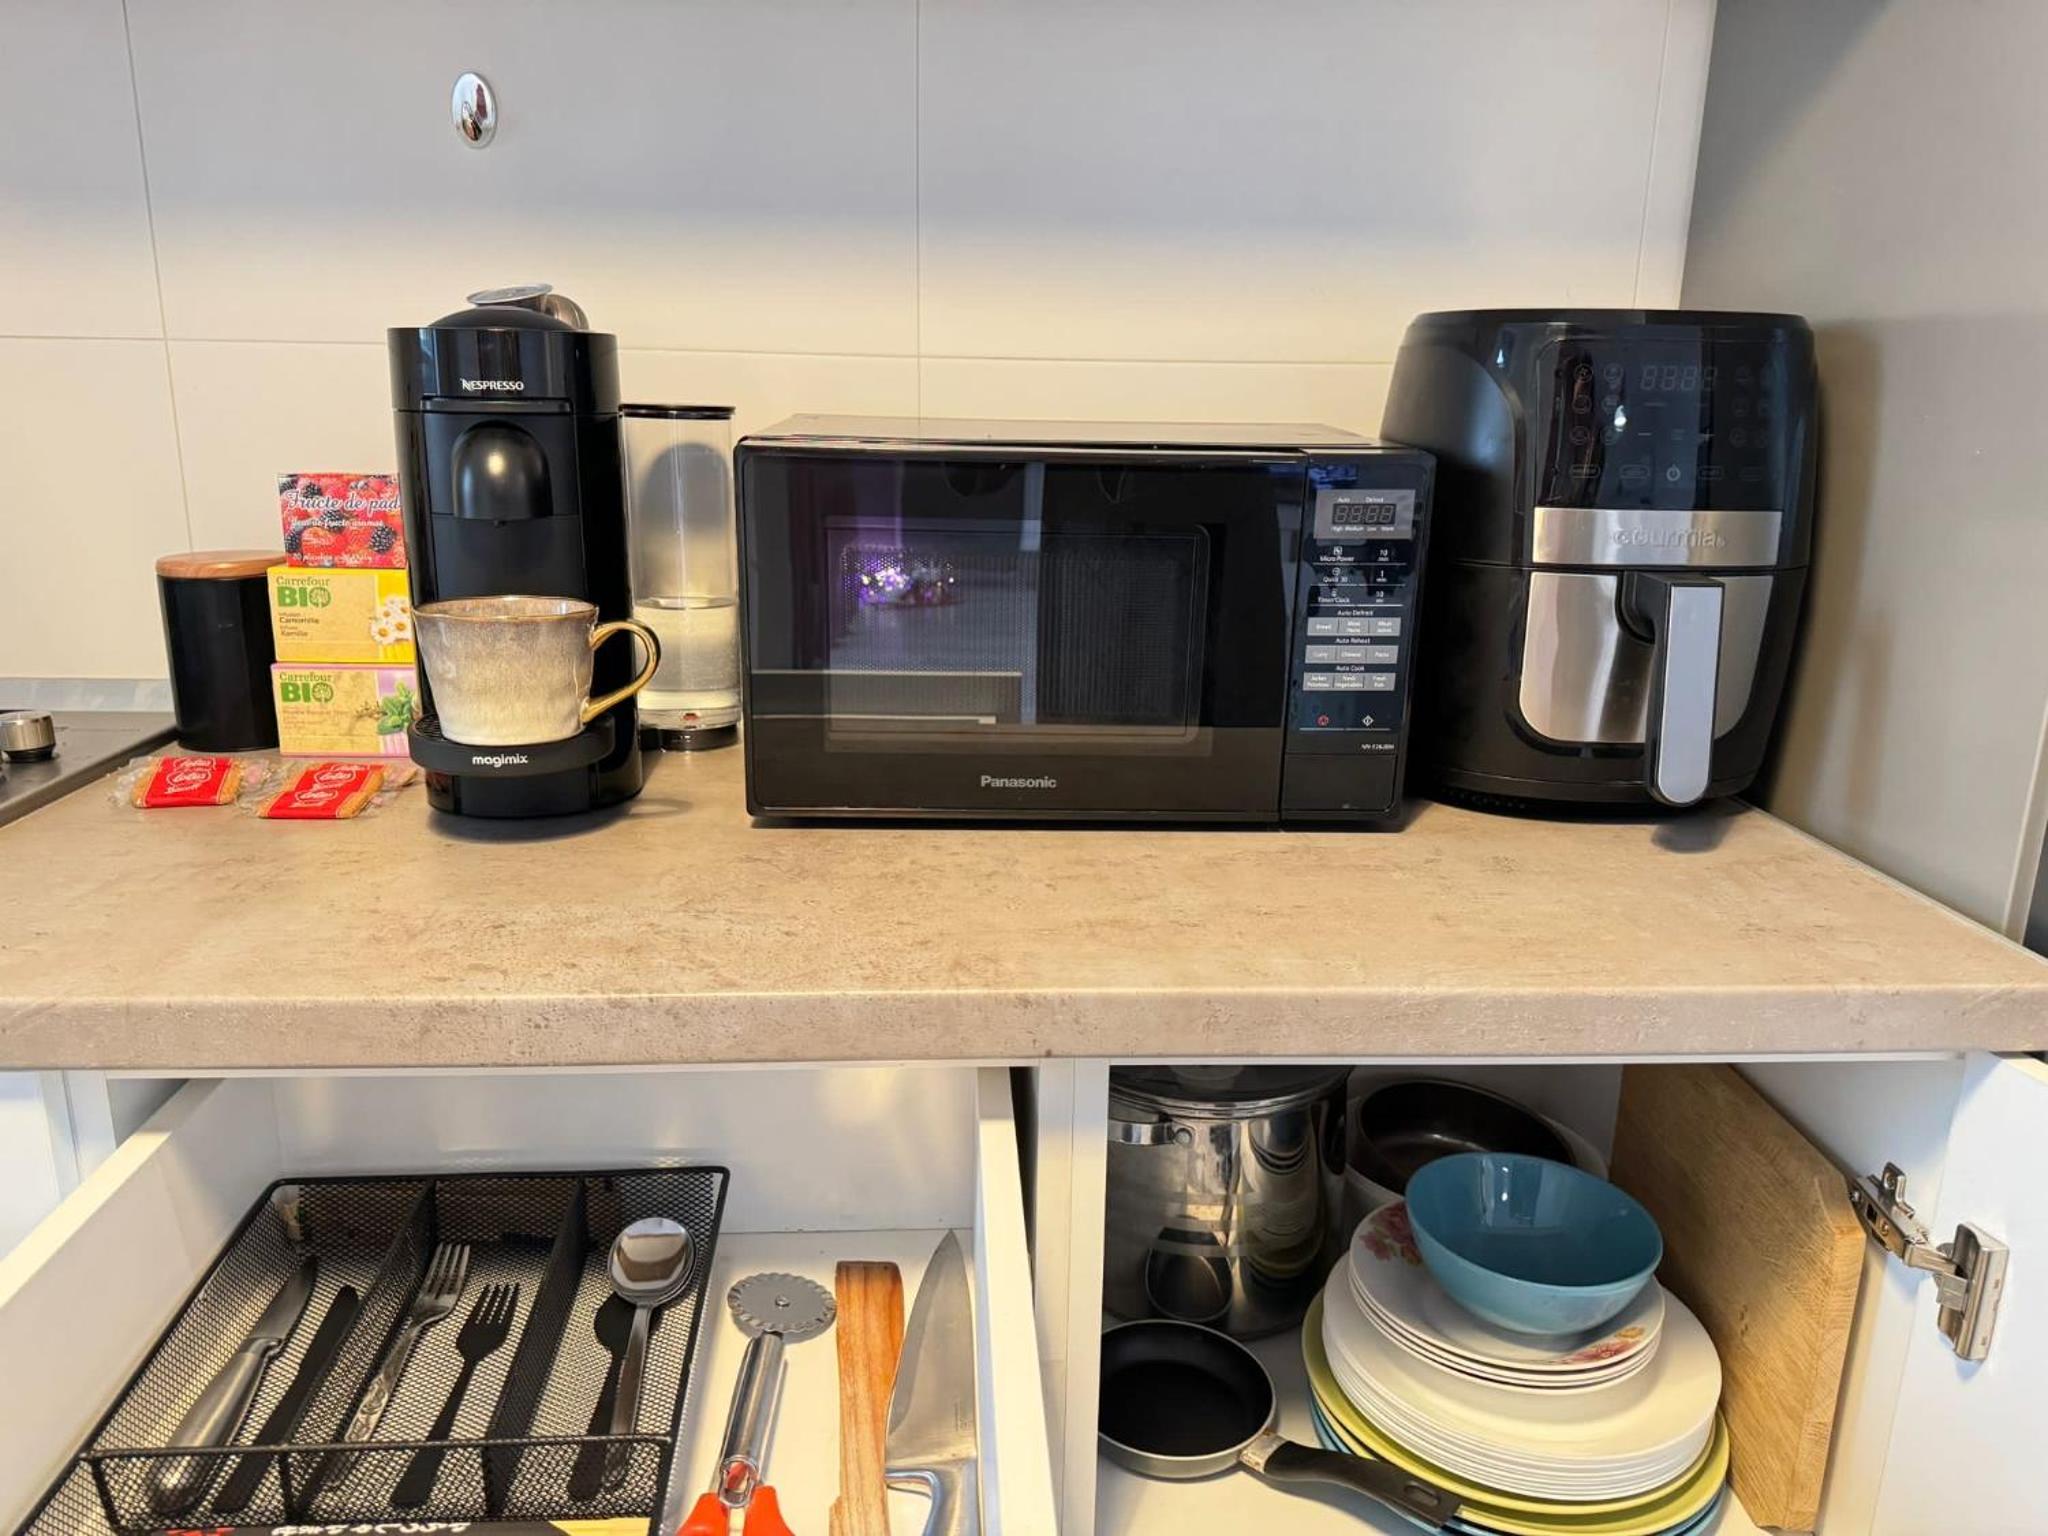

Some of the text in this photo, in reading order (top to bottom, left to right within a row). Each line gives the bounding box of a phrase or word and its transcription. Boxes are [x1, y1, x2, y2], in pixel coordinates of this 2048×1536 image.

[460, 378, 525, 391] NESPRESSO
[286, 489, 401, 516] Fructe de pad
[276, 575, 331, 587] Carrefour
[277, 586, 332, 608] BIO
[279, 671, 333, 682] Carrefour
[281, 682, 334, 703] BIO
[472, 753, 529, 768] magimix
[980, 774, 1057, 789] Panasonic
